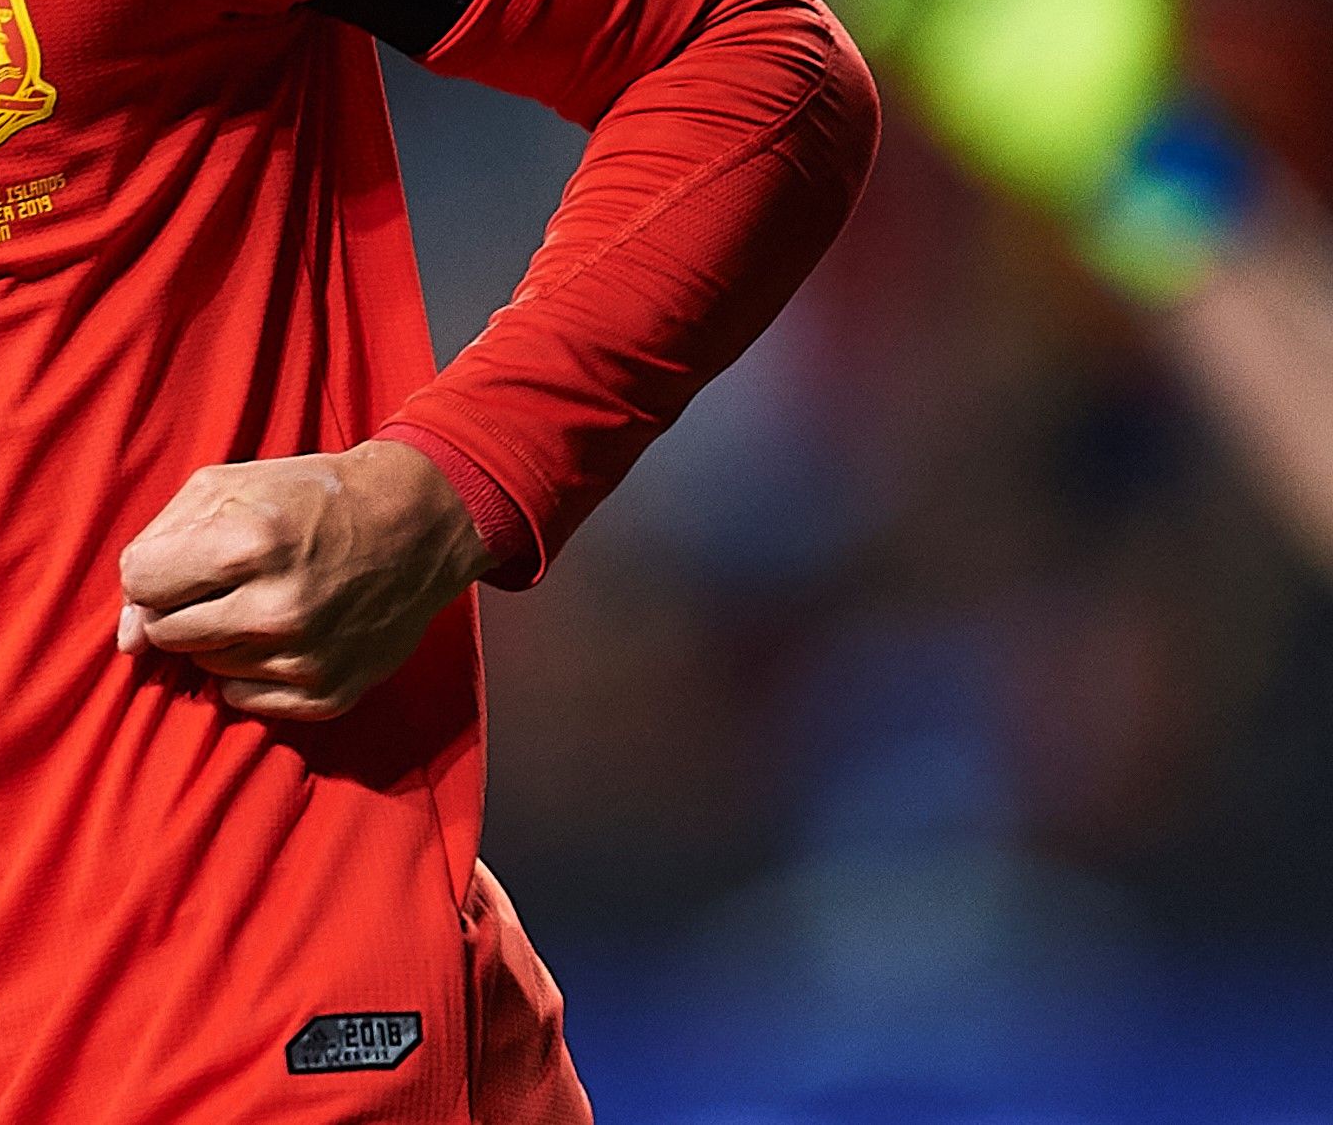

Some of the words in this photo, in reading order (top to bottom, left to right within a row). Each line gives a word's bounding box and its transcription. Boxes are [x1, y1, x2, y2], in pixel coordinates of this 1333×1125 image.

[6, 172, 67, 202] ISLANDS
[17, 194, 54, 220] 2019
[344, 1021, 403, 1048] 2018
